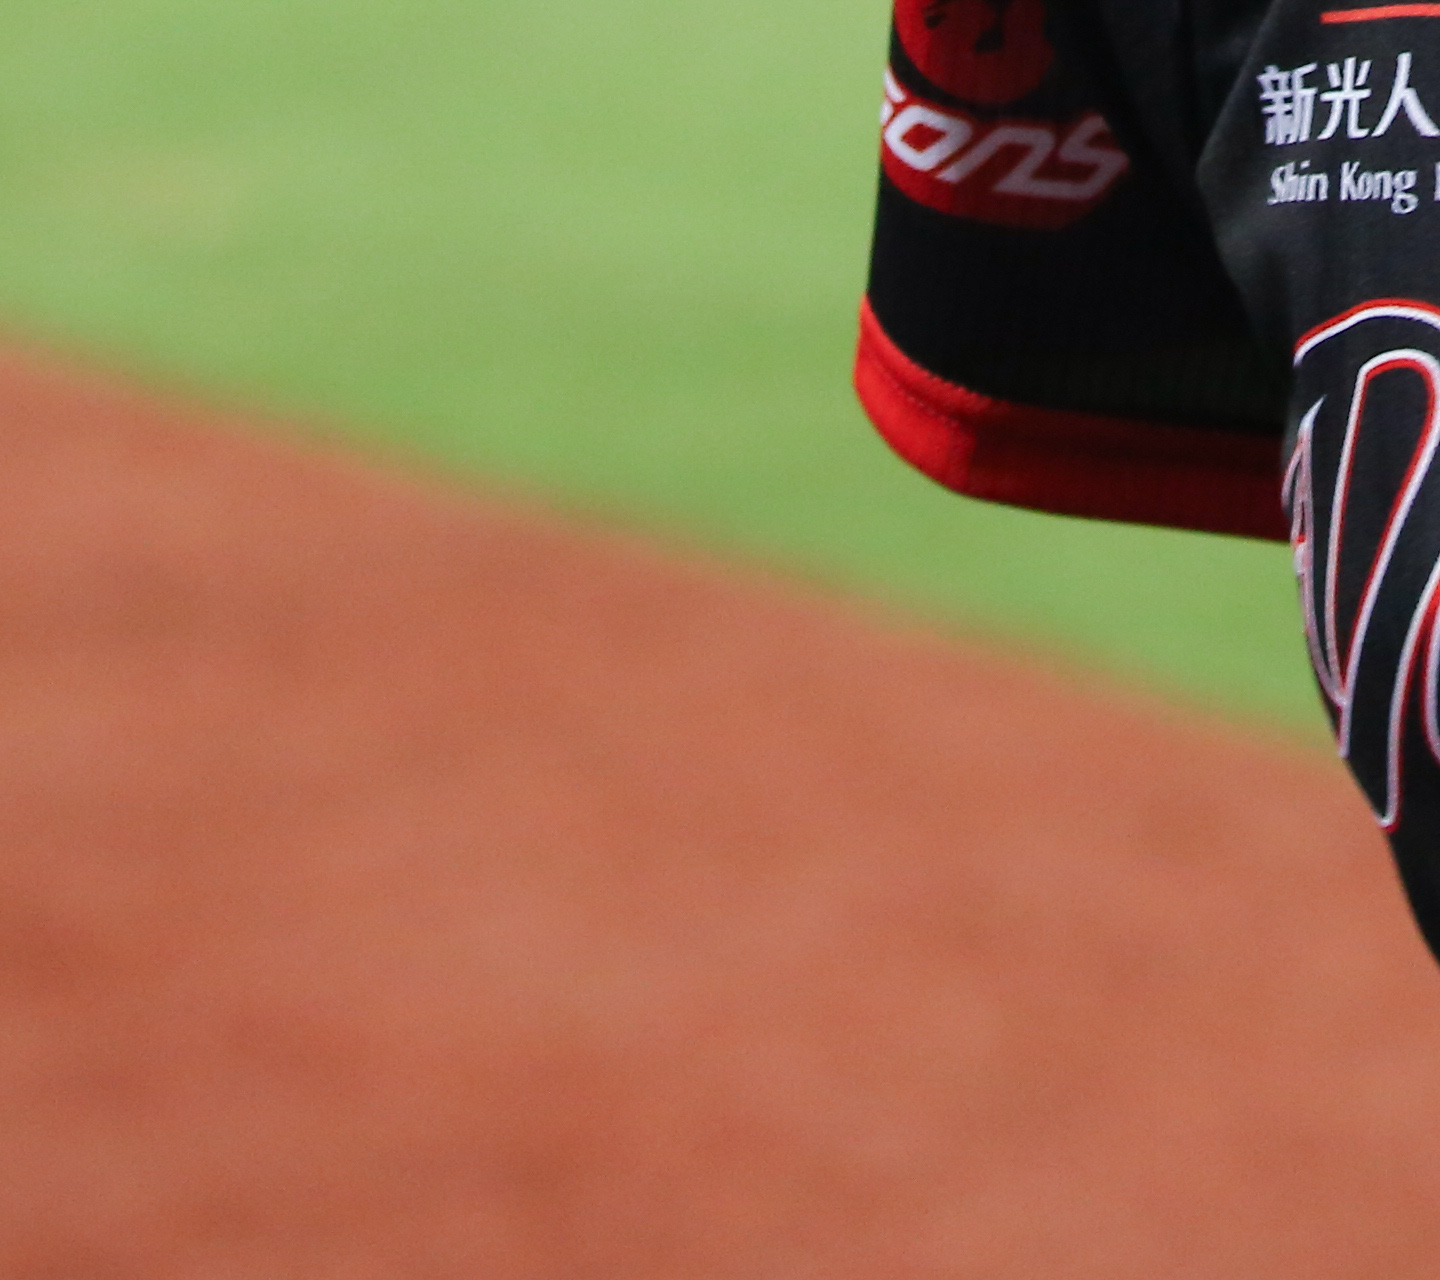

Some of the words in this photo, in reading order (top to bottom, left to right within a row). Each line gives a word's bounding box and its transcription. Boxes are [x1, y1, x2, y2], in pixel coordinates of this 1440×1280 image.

[880, 64, 1130, 201] ons
[1267, 160, 1329, 206] Shin
[1340, 160, 1418, 214] Kong
